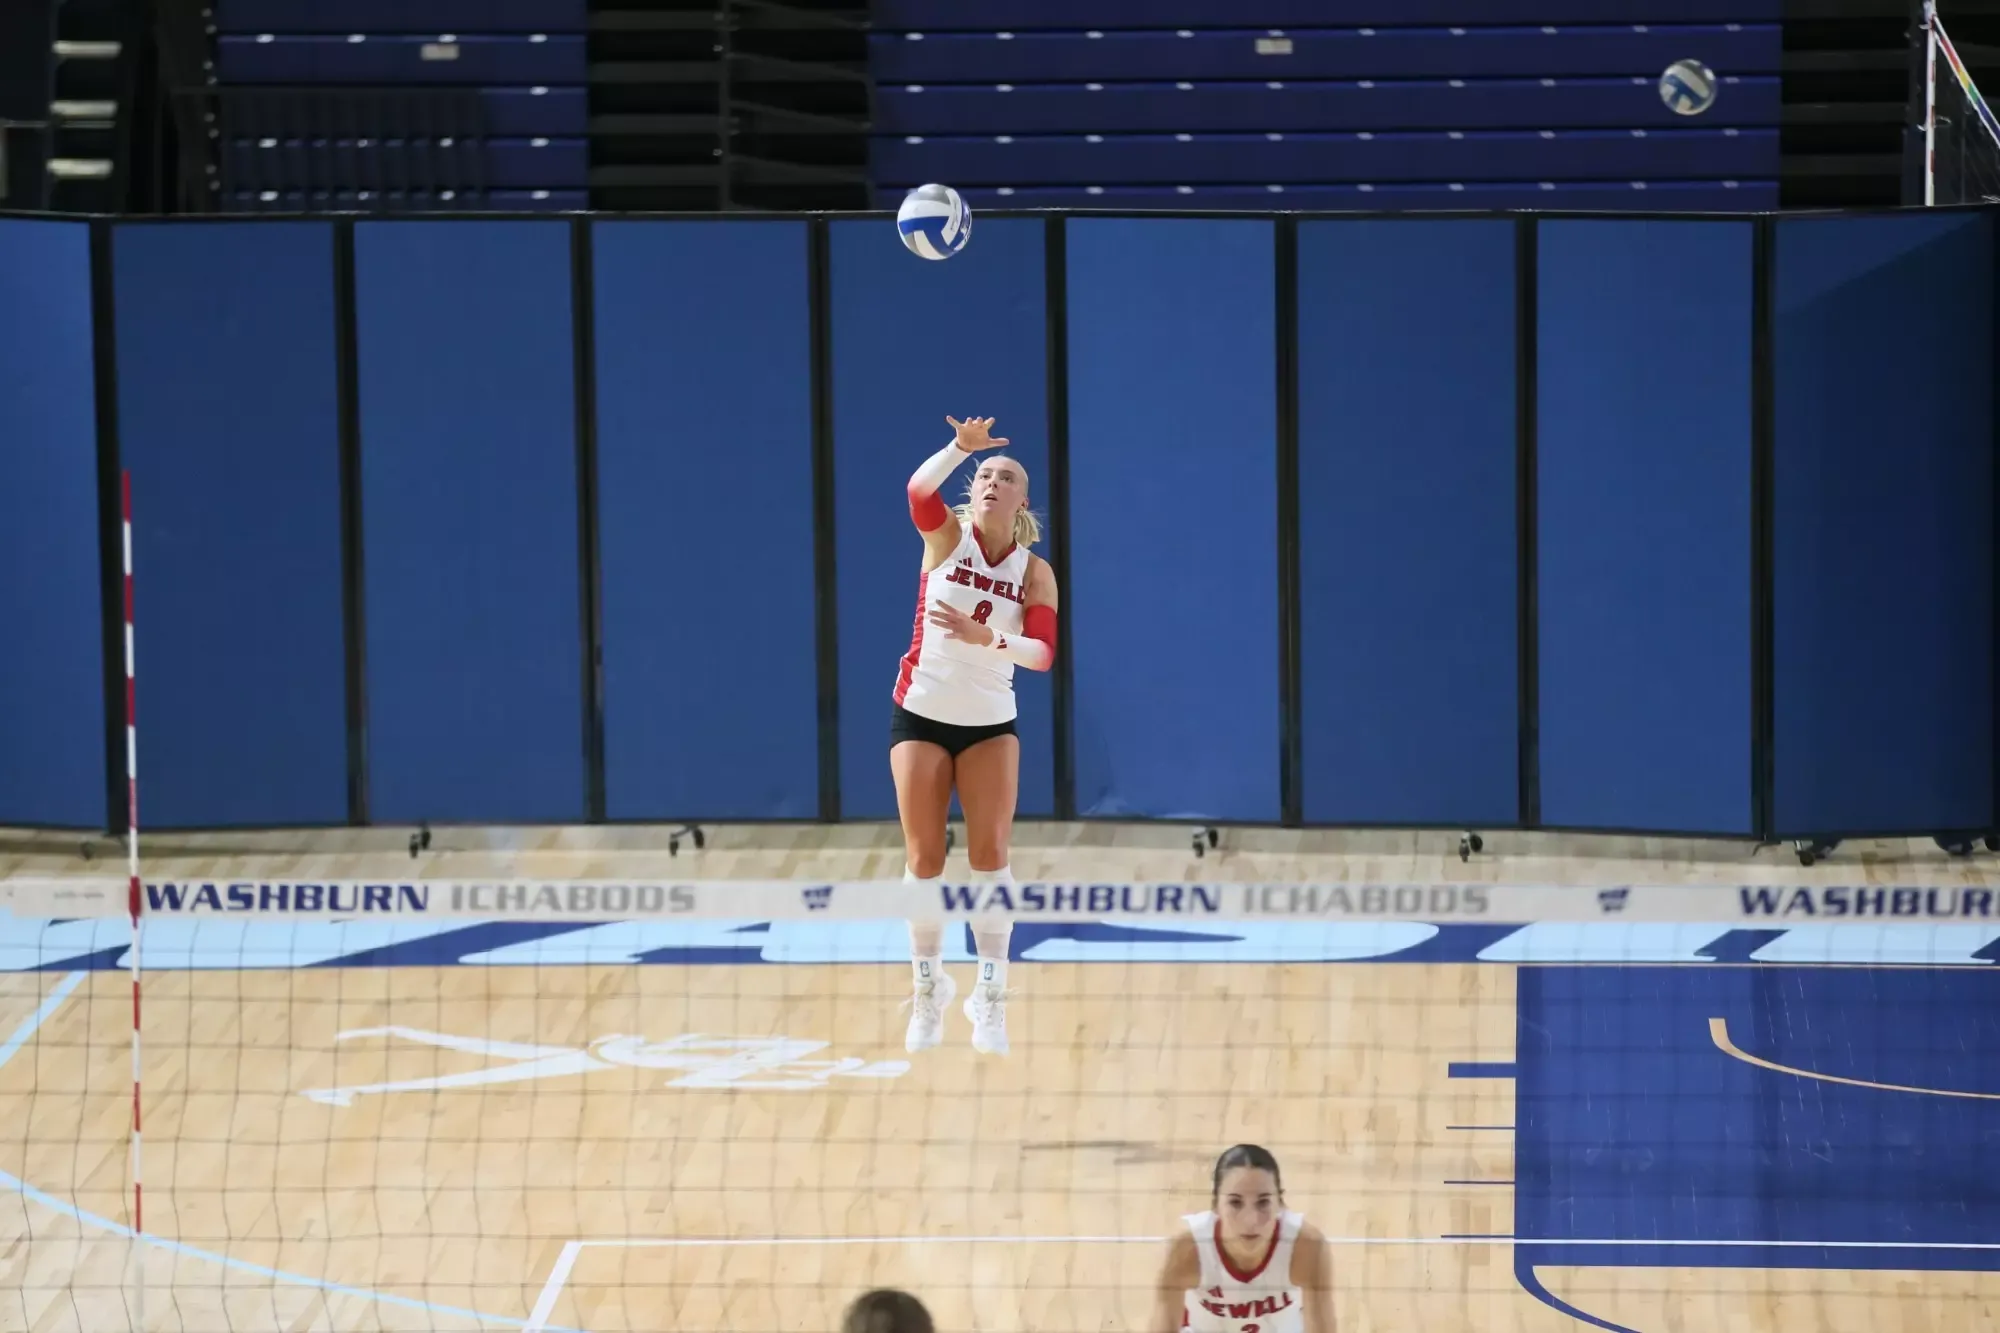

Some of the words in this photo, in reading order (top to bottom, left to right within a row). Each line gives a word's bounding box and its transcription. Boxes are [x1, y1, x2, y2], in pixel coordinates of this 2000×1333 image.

[145, 884, 430, 911] WASHBURN
[451, 885, 696, 912] ICHABODS
[941, 886, 1221, 913] WASHBURN
[1243, 887, 1491, 914] ICHABODS
[1739, 886, 2000, 916] WASHBUR
